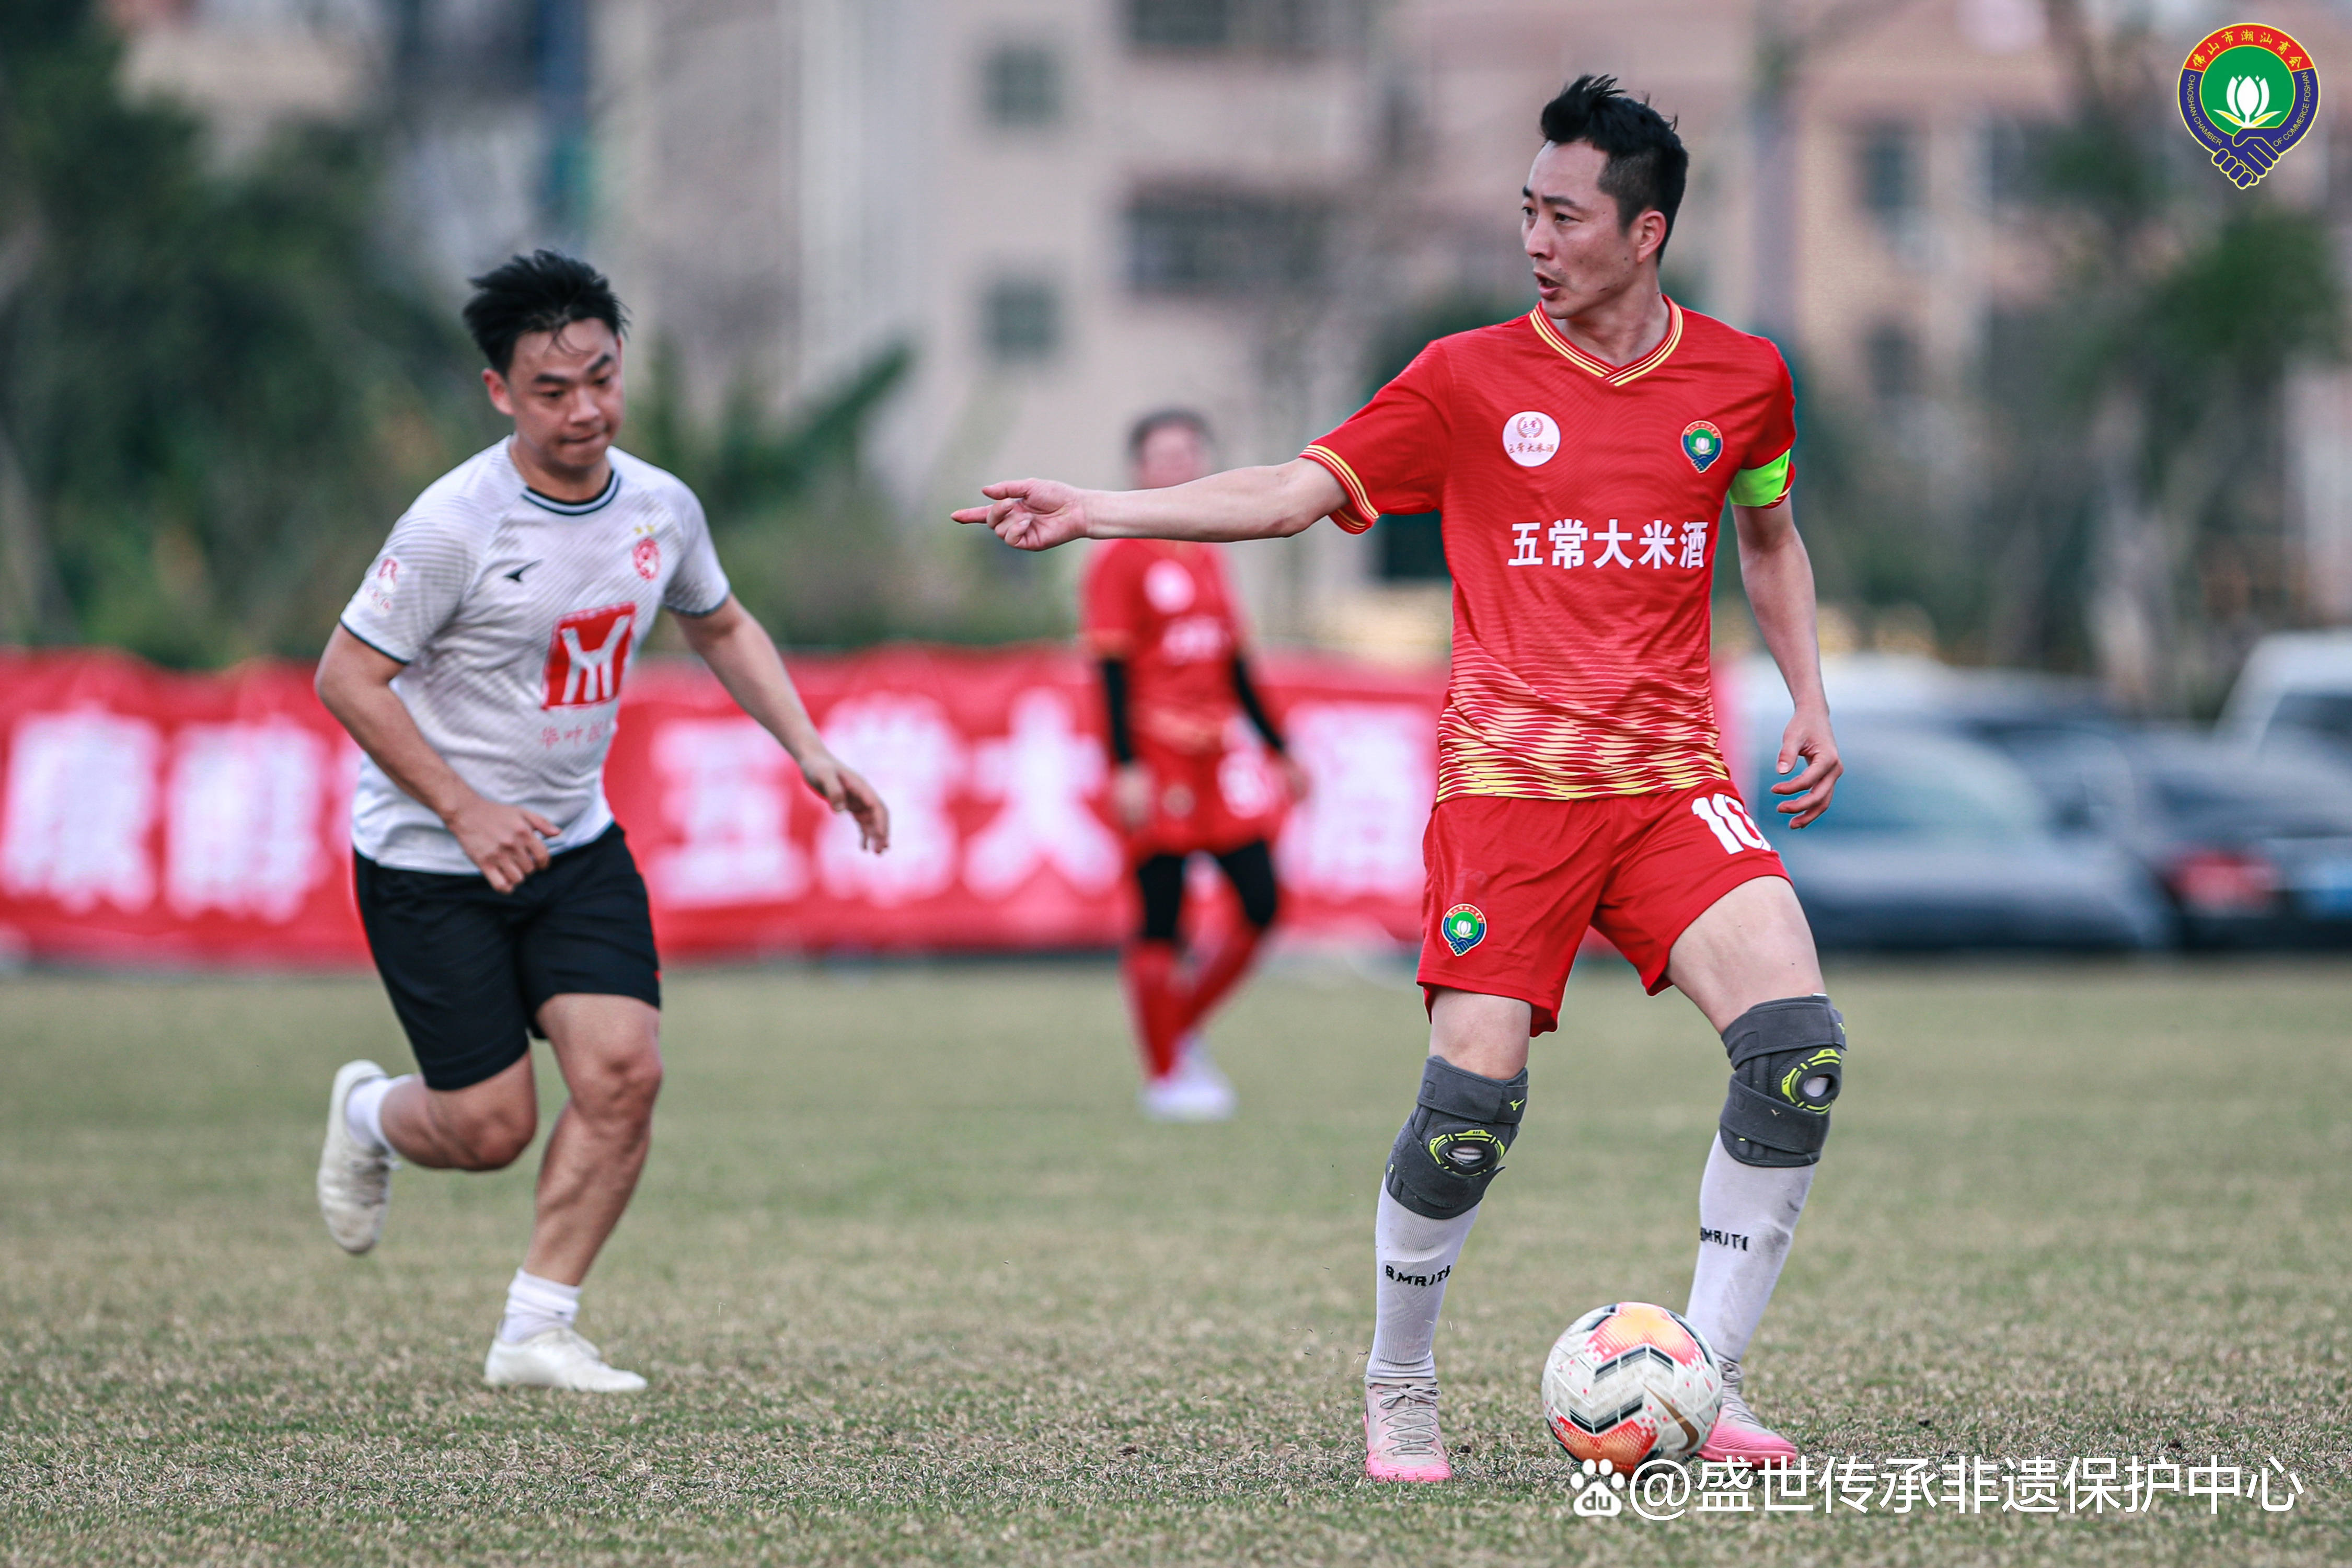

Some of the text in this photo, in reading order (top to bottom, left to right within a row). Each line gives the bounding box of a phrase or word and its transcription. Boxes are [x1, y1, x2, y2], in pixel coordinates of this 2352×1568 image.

[1507, 518, 1709, 569] 五常大米酒
[1690, 793, 1772, 855] 10
